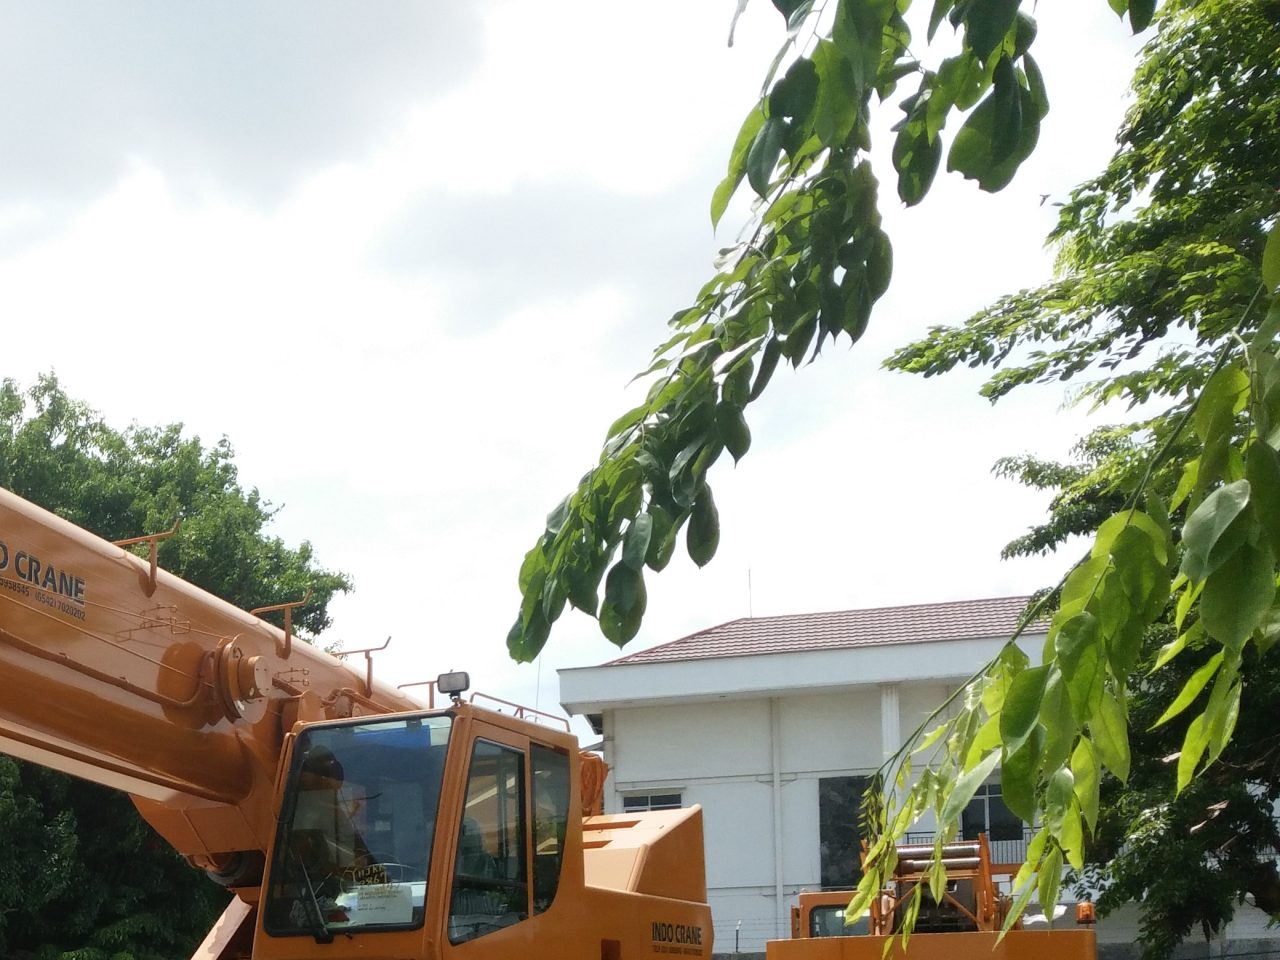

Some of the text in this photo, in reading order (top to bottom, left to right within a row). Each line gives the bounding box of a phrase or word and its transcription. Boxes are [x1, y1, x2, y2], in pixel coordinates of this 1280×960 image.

[15, 551, 86, 607] CRANE
[651, 921, 702, 946] INDO CRANE
